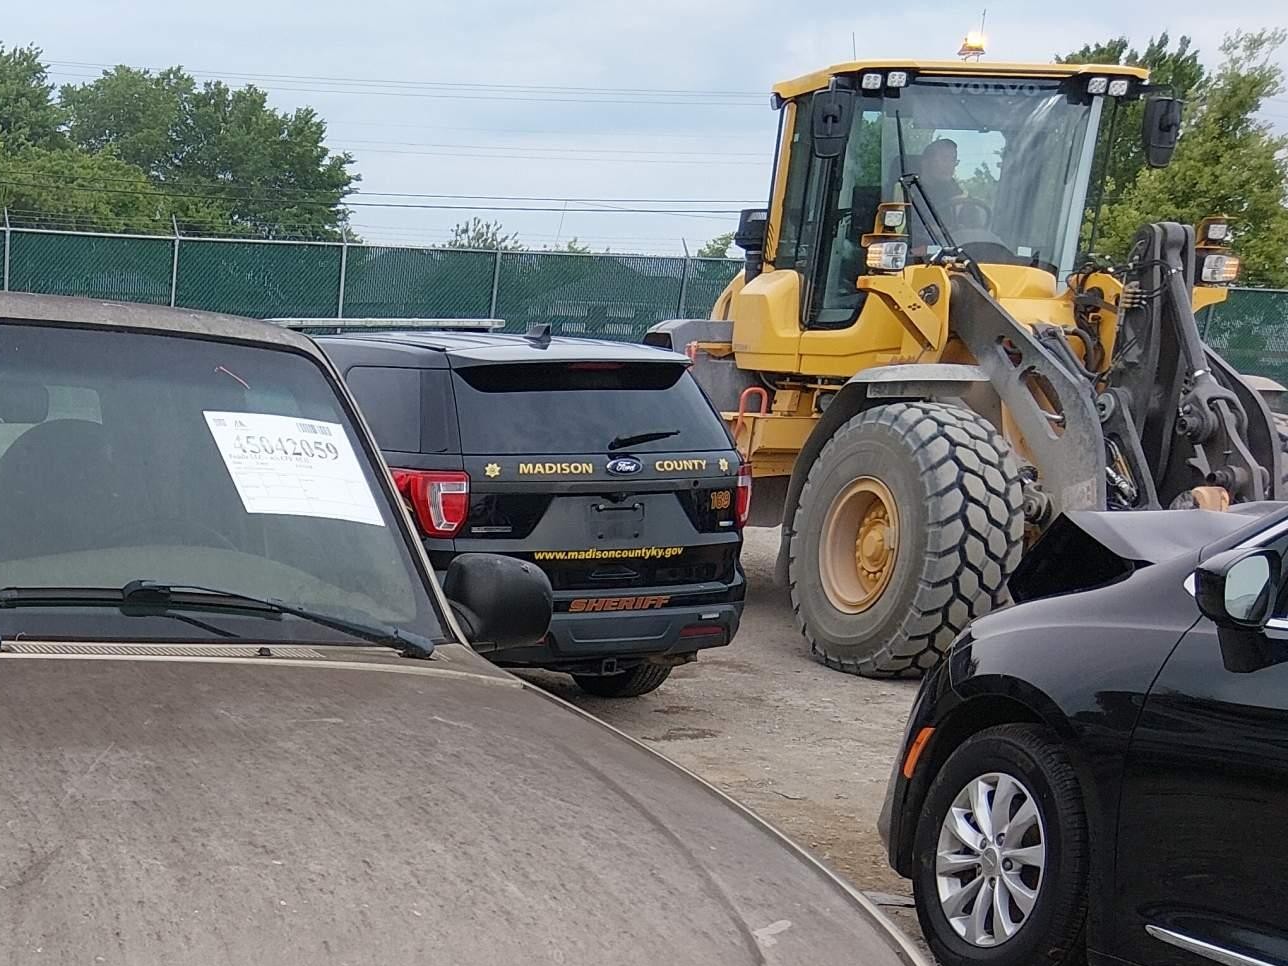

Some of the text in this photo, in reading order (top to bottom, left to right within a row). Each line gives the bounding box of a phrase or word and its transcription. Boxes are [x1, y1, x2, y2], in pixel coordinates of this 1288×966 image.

[949, 81, 1041, 97] VOLVO
[233, 434, 339, 461] 45042059
[519, 459, 707, 474] MADISON COUNTY
[615, 460, 636, 473] Ford
[533, 546, 684, 561] www.madisoncountyky.gov
[568, 596, 671, 612] SHERIFF
